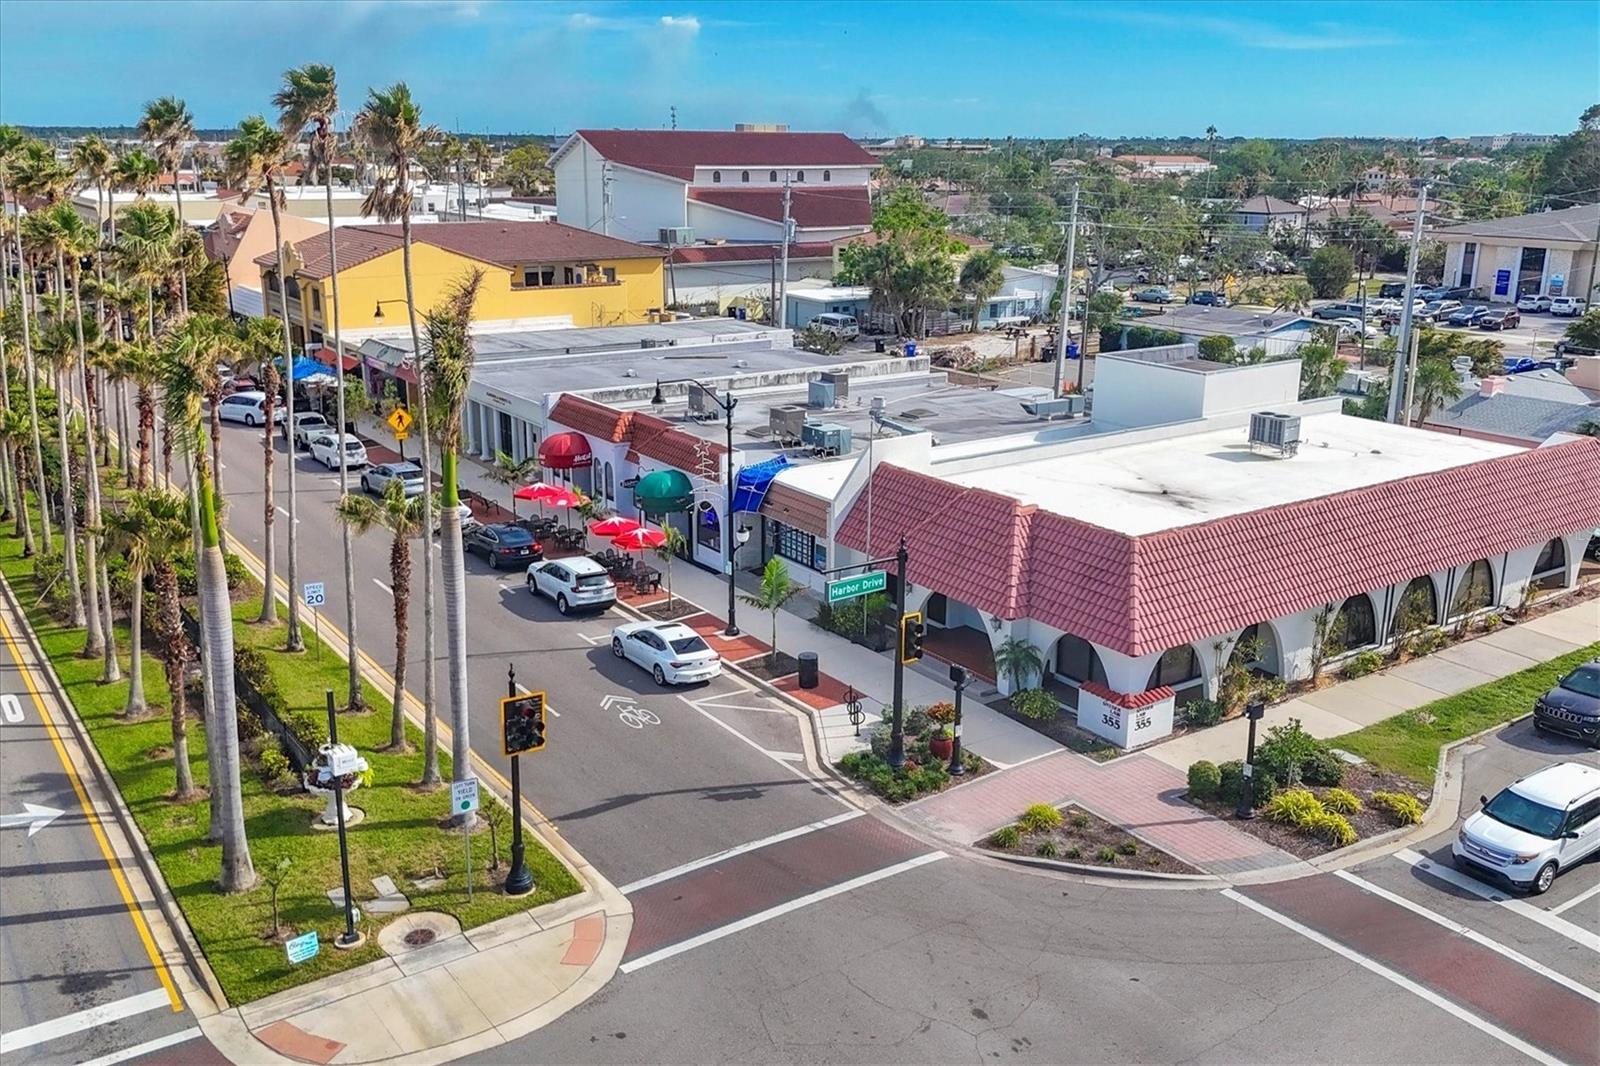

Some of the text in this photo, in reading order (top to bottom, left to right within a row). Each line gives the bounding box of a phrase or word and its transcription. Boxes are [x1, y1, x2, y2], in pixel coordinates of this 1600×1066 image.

[831, 578, 883, 597] Harbor Drive
[307, 594, 324, 604] 20
[1101, 714, 1120, 730] 355
[1134, 717, 1152, 731] 355
